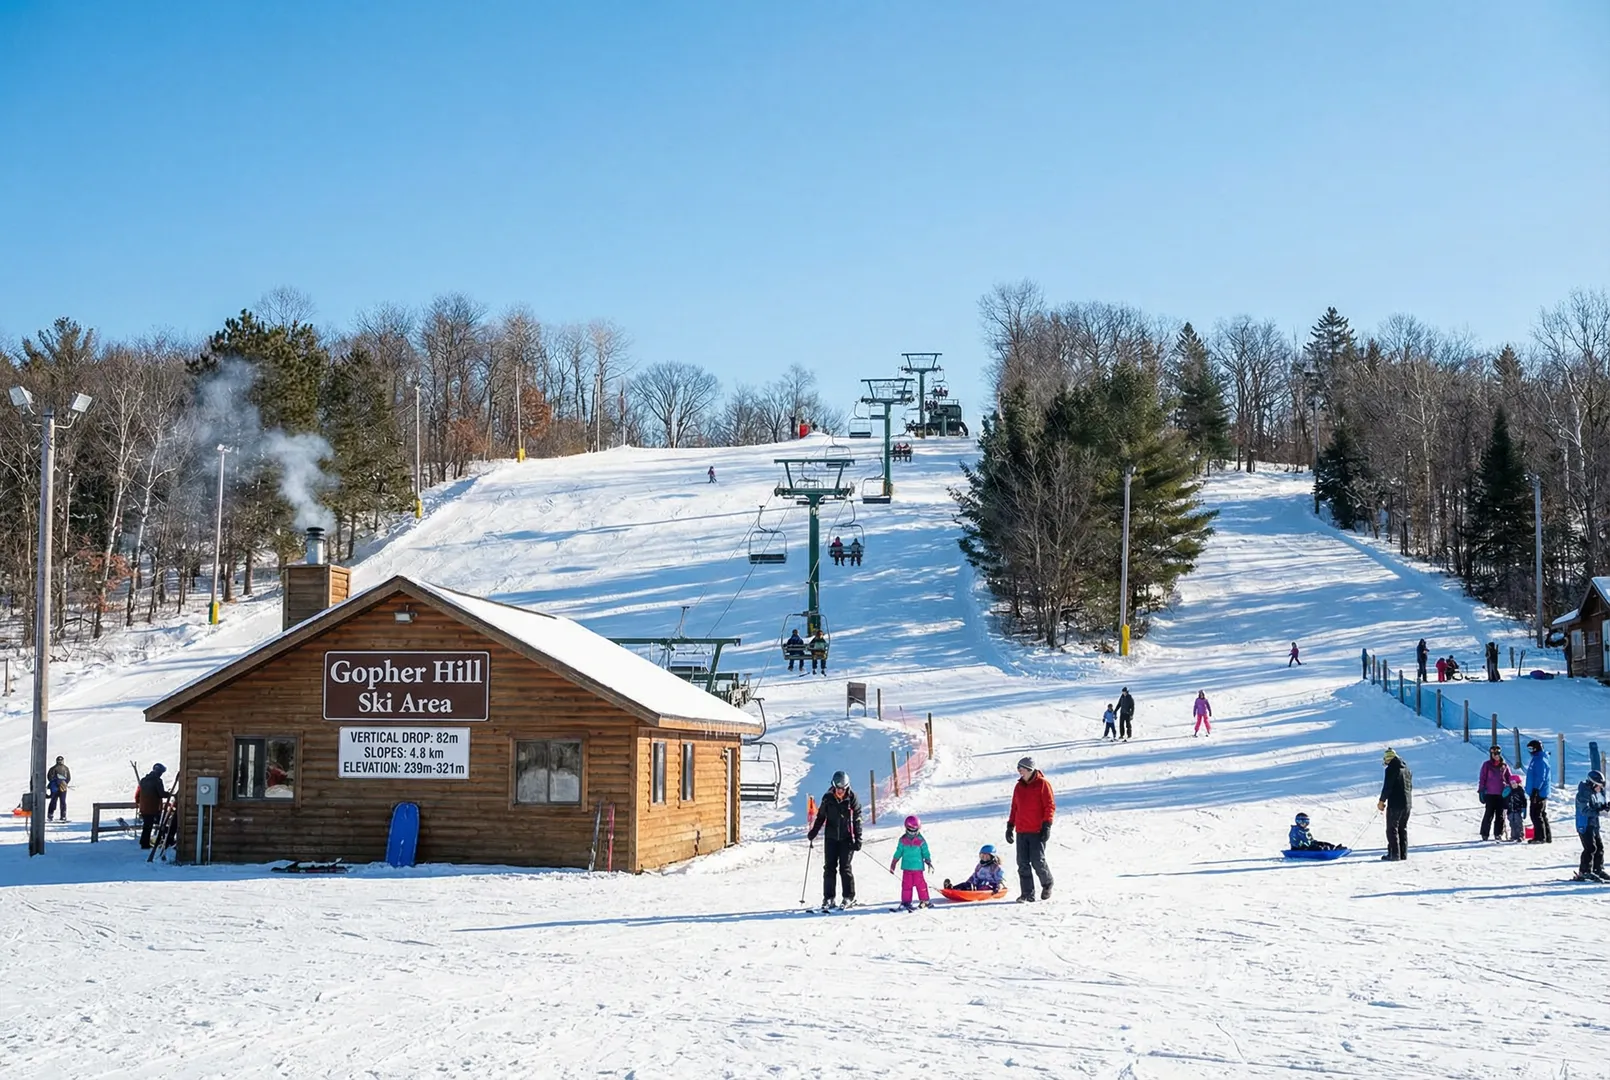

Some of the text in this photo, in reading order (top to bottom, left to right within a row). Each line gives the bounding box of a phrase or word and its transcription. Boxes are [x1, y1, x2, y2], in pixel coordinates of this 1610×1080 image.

[330, 659, 483, 690] Gopher Hill
[358, 691, 453, 713] Ski Area
[350, 731, 459, 744] VERTICAL DROP: 82m
[363, 747, 444, 759] SLOPES: 4.8 km
[343, 761, 465, 774] ELEVATION: 239m-321m
